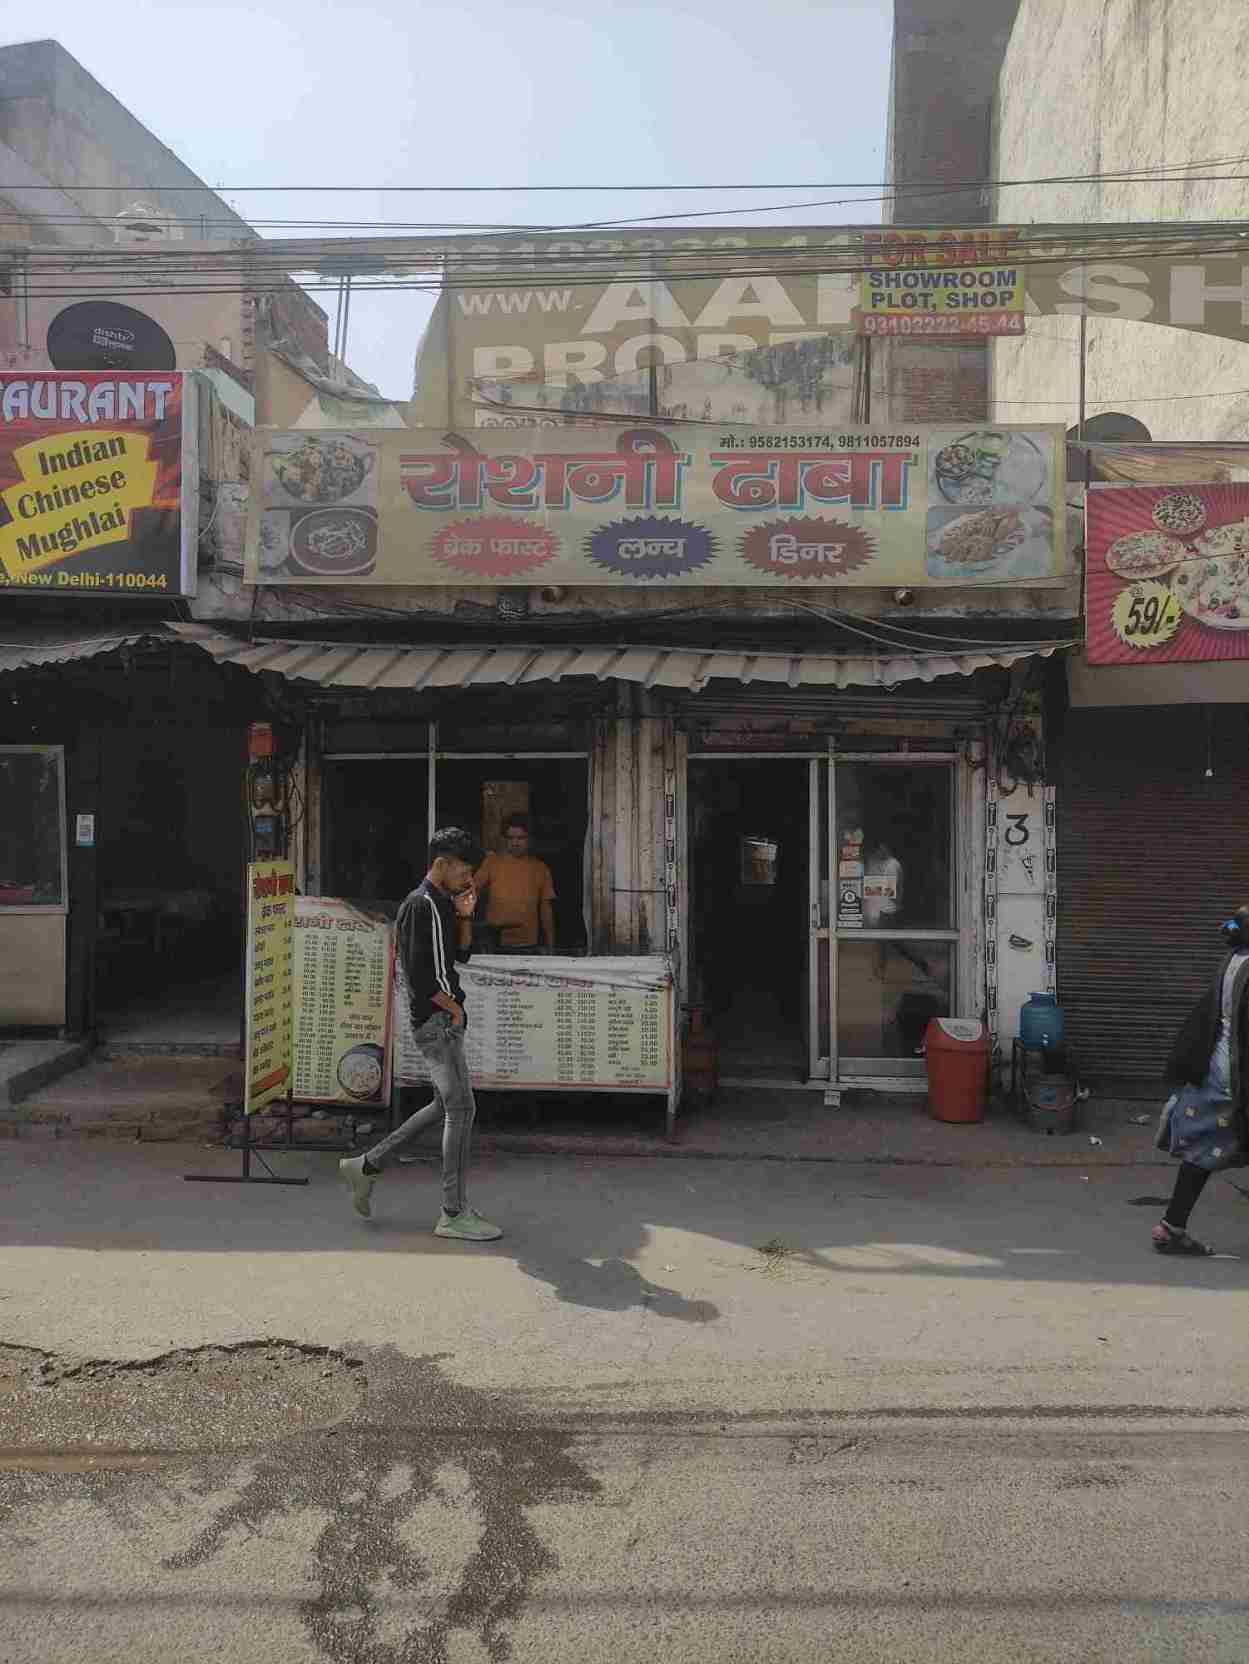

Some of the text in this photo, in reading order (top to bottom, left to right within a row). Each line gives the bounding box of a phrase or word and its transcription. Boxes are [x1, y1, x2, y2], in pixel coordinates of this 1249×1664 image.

[870, 271, 1017, 289] SHOWROOM
[872, 291, 1014, 311] PLOT, SHOP
[0, 381, 172, 423] AURANT
[37, 436, 127, 476] Indian
[400, 430, 917, 511] रोशनी ढाबा
[17, 470, 128, 520] Chinese
[16, 502, 126, 561] Mughlai
[617, 538, 687, 559] लन्च
[768, 533, 848, 563] डिनर
[1124, 594, 1175, 635] 59/-
[1005, 813, 1029, 846] 3
